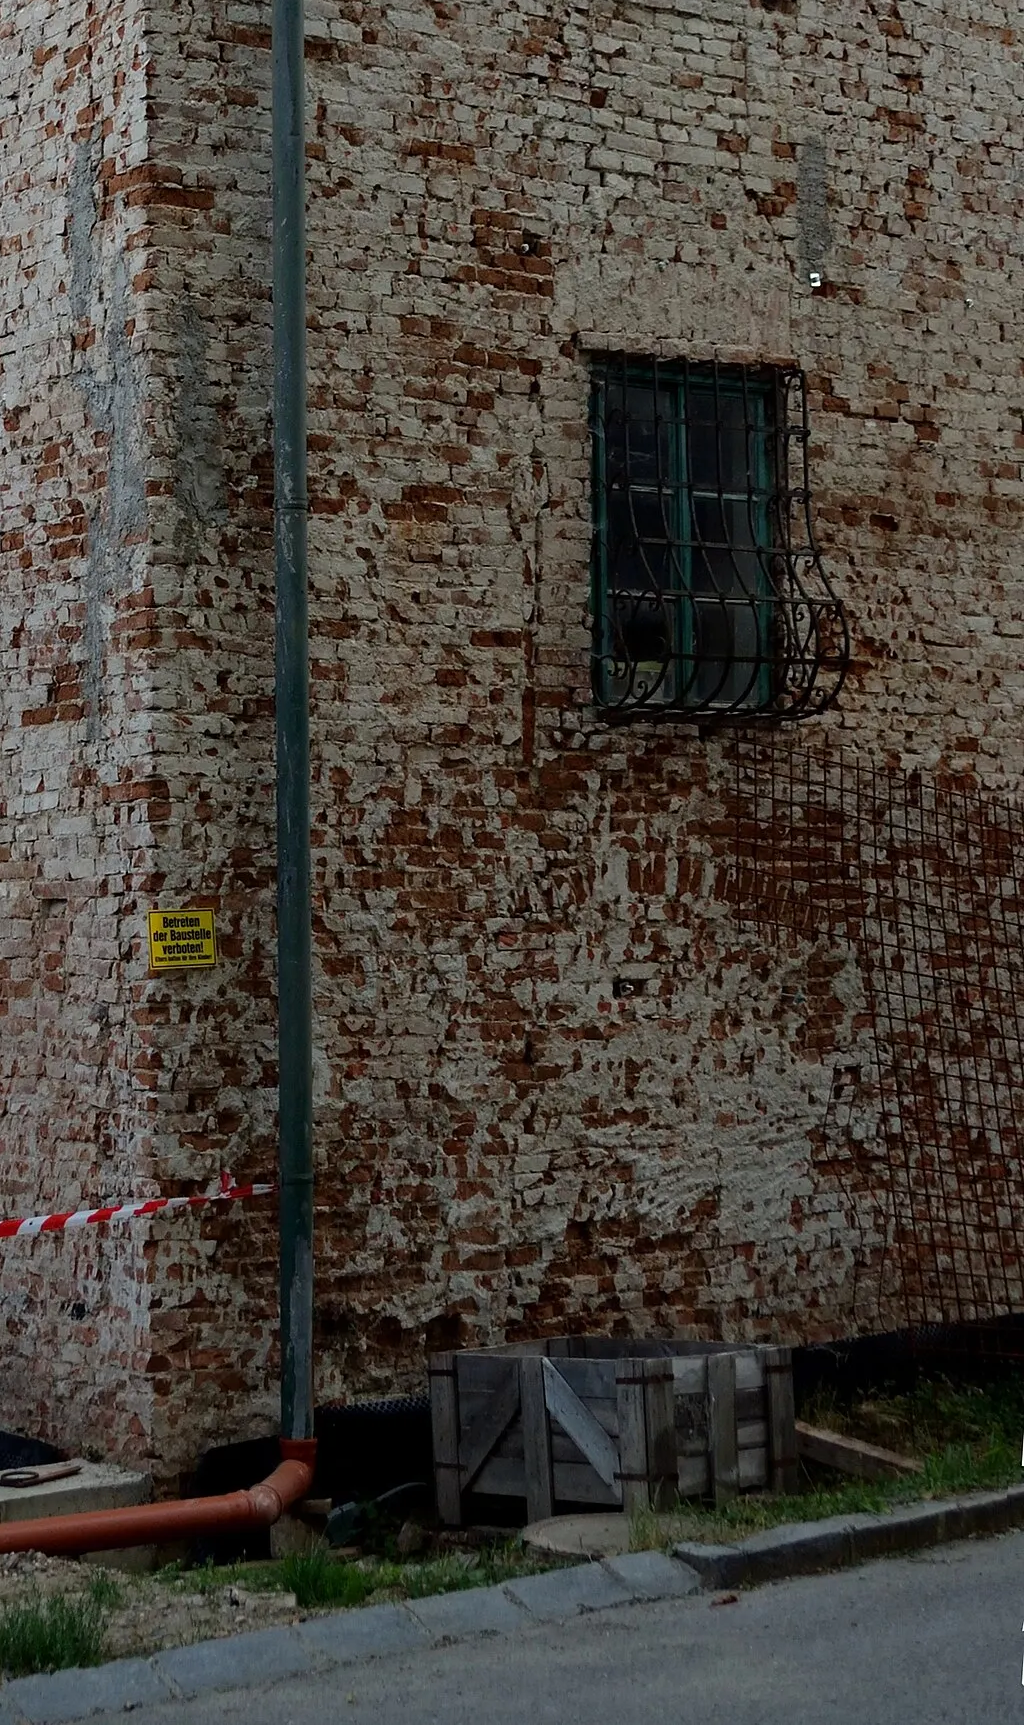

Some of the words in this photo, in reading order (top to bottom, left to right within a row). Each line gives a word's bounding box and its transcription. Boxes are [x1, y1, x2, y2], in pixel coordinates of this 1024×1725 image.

[162, 916, 200, 928] Betreten
[153, 930, 167, 942] der
[170, 928, 212, 941] Baustelle
[162, 941, 204, 955] verboten!
